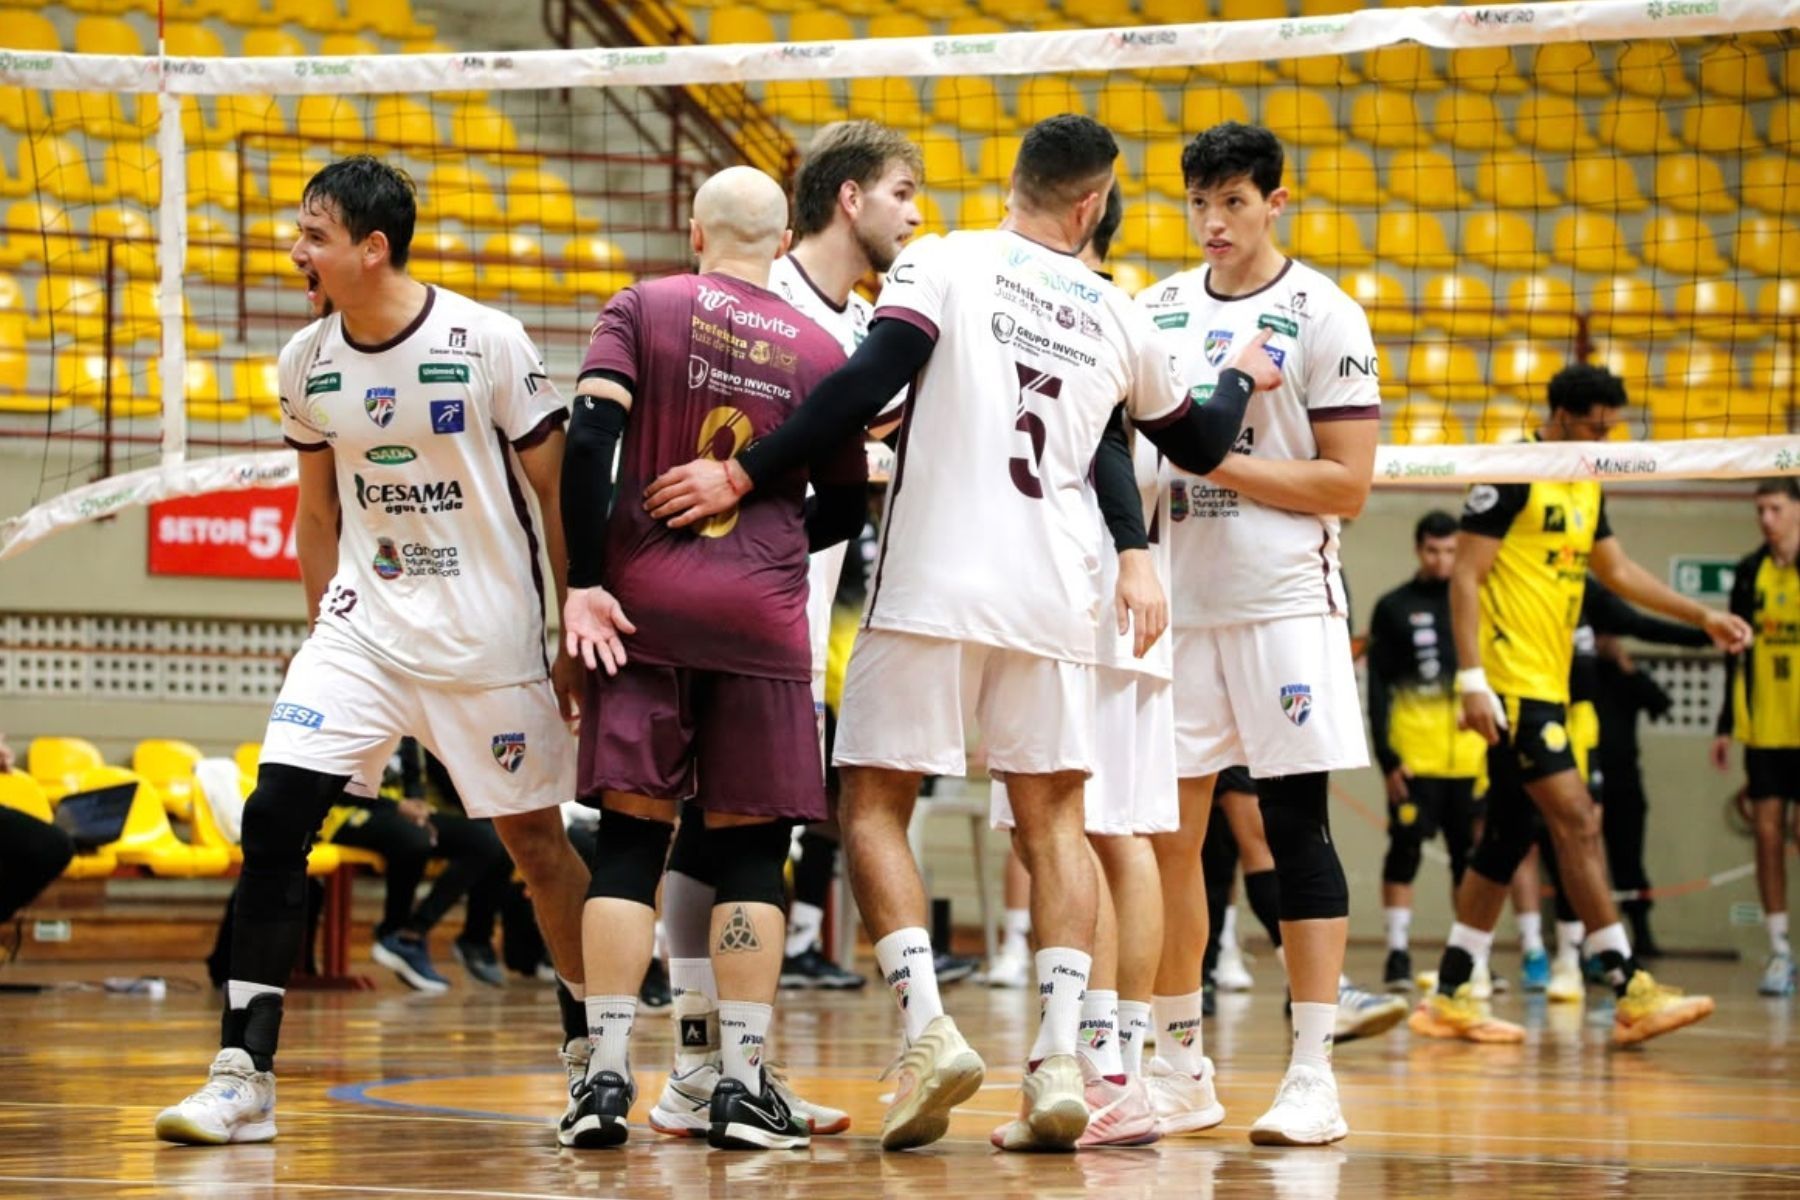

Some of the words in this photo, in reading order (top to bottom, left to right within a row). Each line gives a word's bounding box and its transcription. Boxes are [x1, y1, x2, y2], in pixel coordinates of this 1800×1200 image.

[1017, 325, 1050, 348] GRUPO
[1052, 341, 1097, 367] INVICTUS
[744, 377, 792, 400] INVICTUS
[1009, 360, 1063, 499] 5
[366, 480, 463, 503] CESAMA
[432, 499, 463, 513] vida
[160, 516, 246, 546] SETOR
